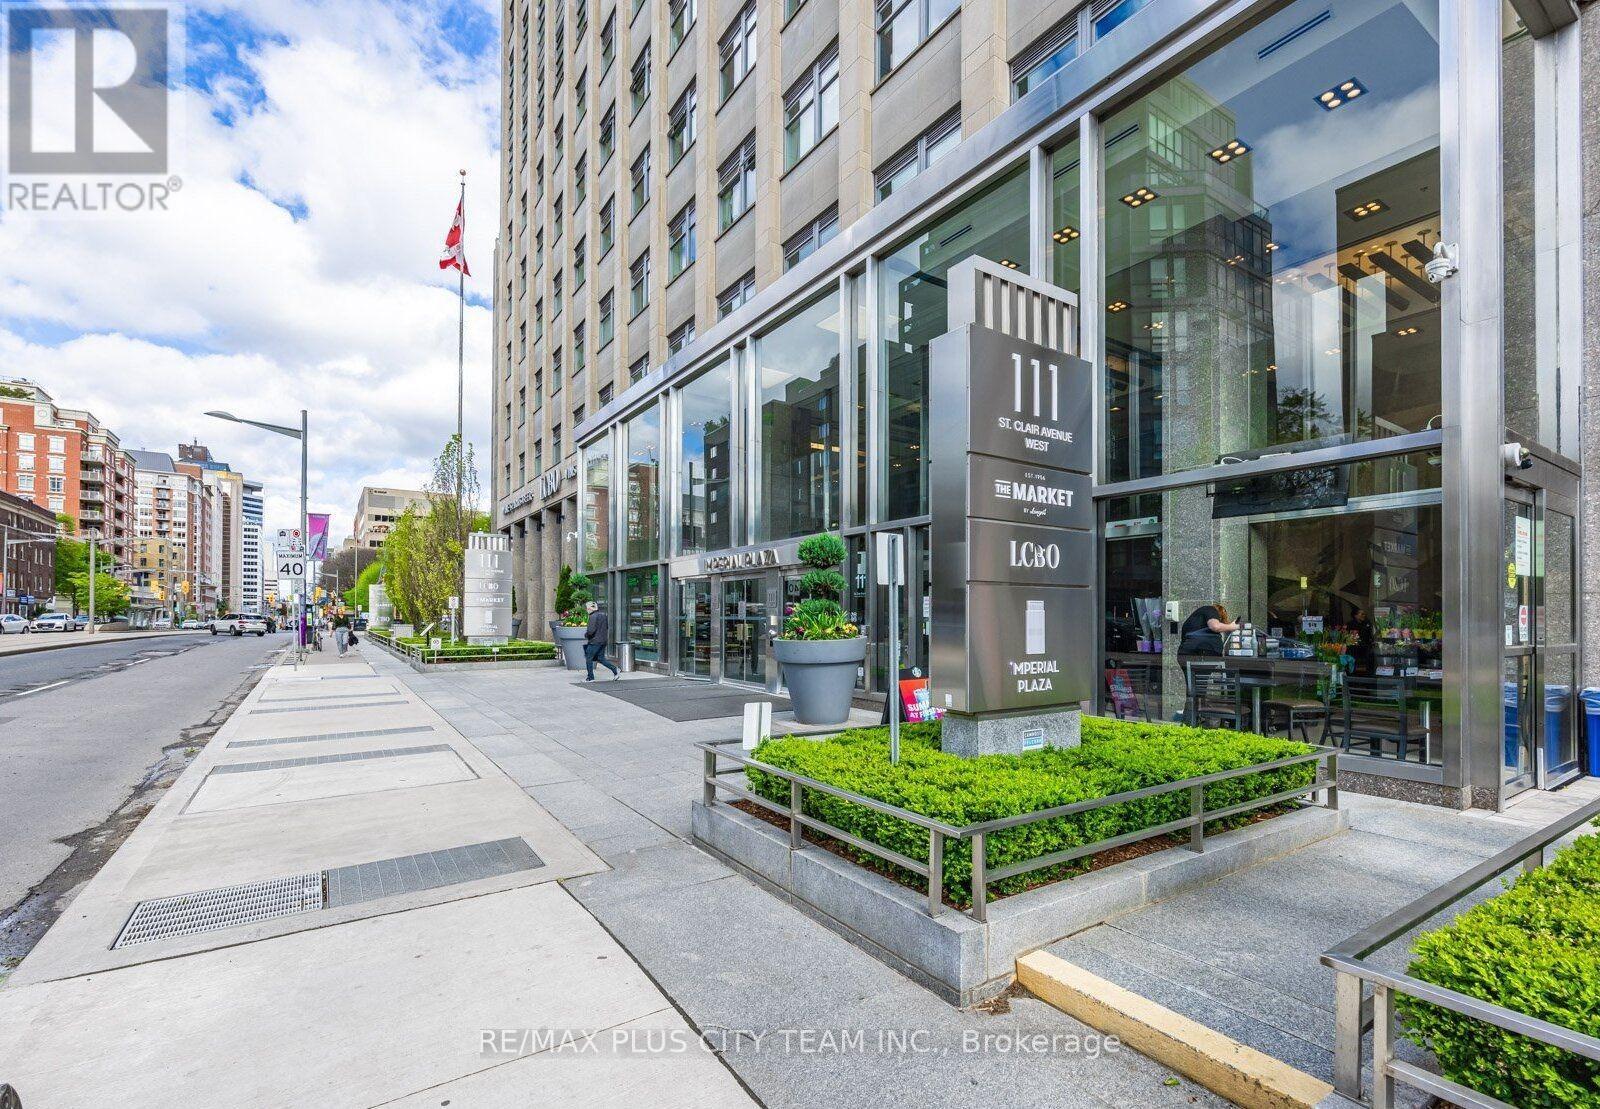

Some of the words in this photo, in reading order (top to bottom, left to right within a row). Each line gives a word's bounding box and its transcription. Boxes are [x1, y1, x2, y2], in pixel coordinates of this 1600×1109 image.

[1011, 352, 1058, 421] 111
[998, 417, 1012, 430] ST.
[1013, 420, 1040, 436] CLAIR
[1040, 426, 1073, 443] AVENUE
[1024, 437, 1049, 452] WEST
[995, 483, 1011, 495] THE
[1012, 481, 1074, 507] MARKET
[480, 553, 499, 568] 111
[745, 547, 780, 569] PLAZA
[1009, 540, 1061, 569] LCBO
[279, 562, 303, 576] 40
[1017, 678, 1053, 693] PLAZA
